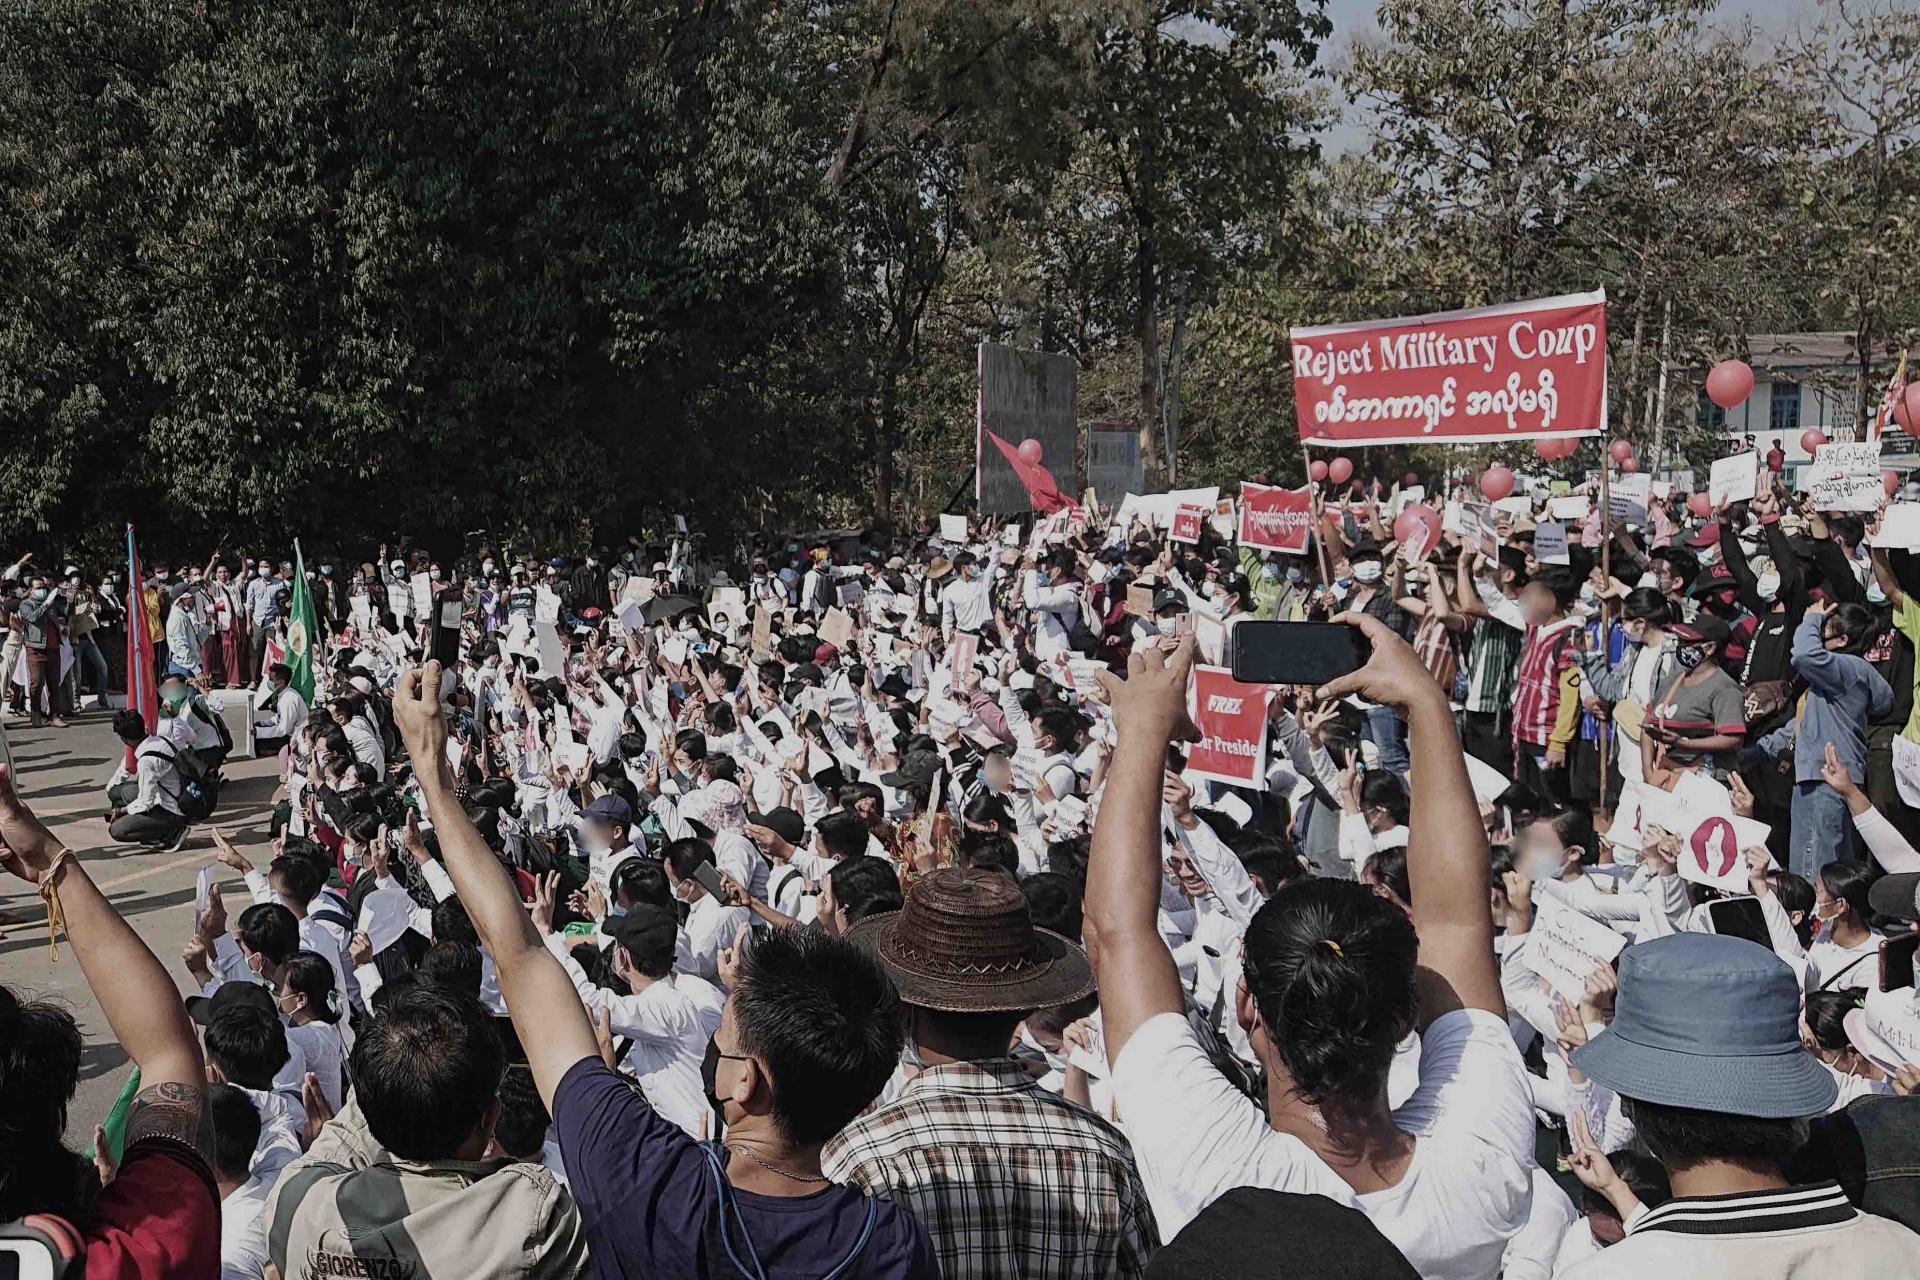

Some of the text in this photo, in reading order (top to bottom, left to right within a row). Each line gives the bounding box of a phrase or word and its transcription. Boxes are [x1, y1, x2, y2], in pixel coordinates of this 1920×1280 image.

[1294, 320, 1596, 385] Reject Military Coup
[1465, 369, 1558, 429] အလိုမရှိ
[316, 1252, 401, 1280] GIORENZO
